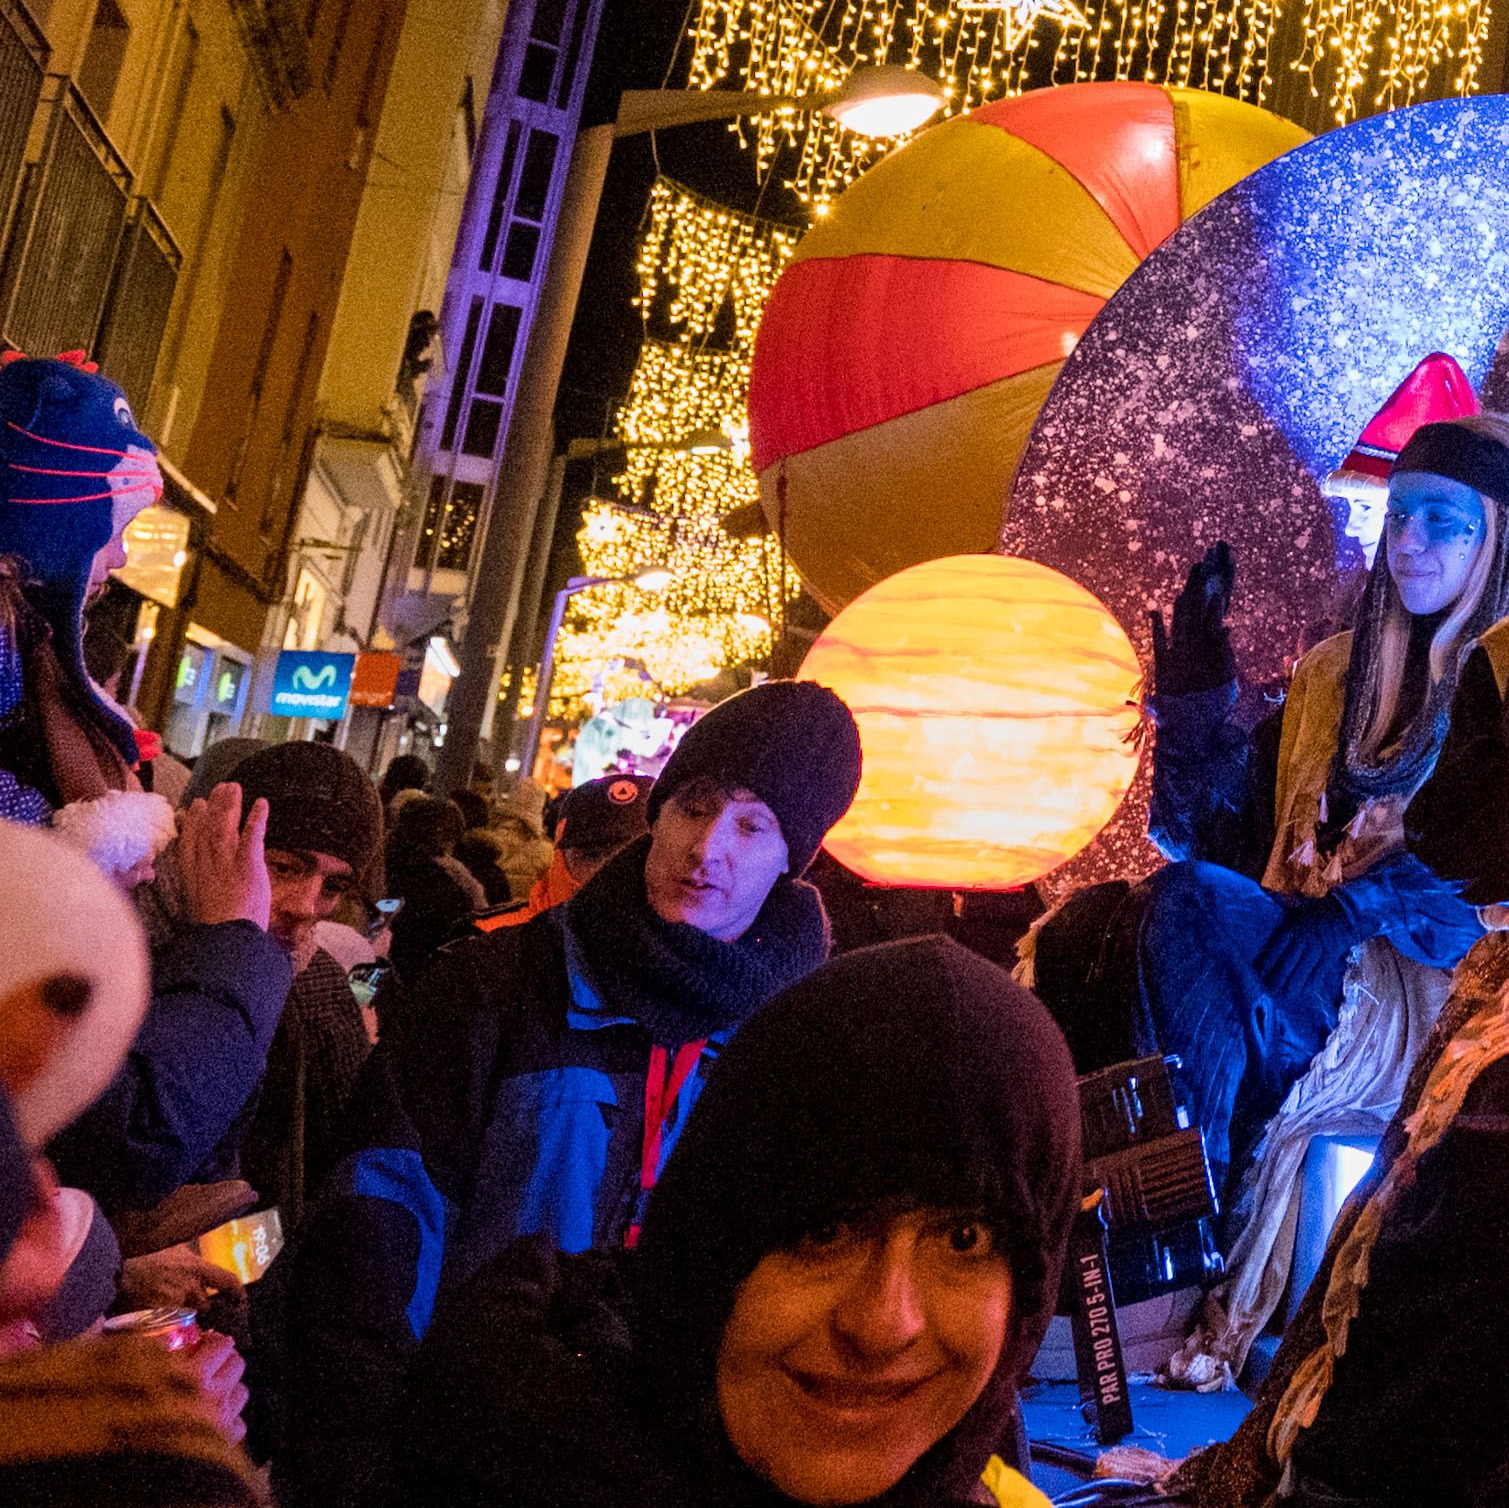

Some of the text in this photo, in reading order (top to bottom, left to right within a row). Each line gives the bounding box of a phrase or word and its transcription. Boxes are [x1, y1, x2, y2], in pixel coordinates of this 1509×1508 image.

[275, 692, 342, 707] movistar
[1079, 1253, 1121, 1406] PAR PRO 270 5-IN-1
